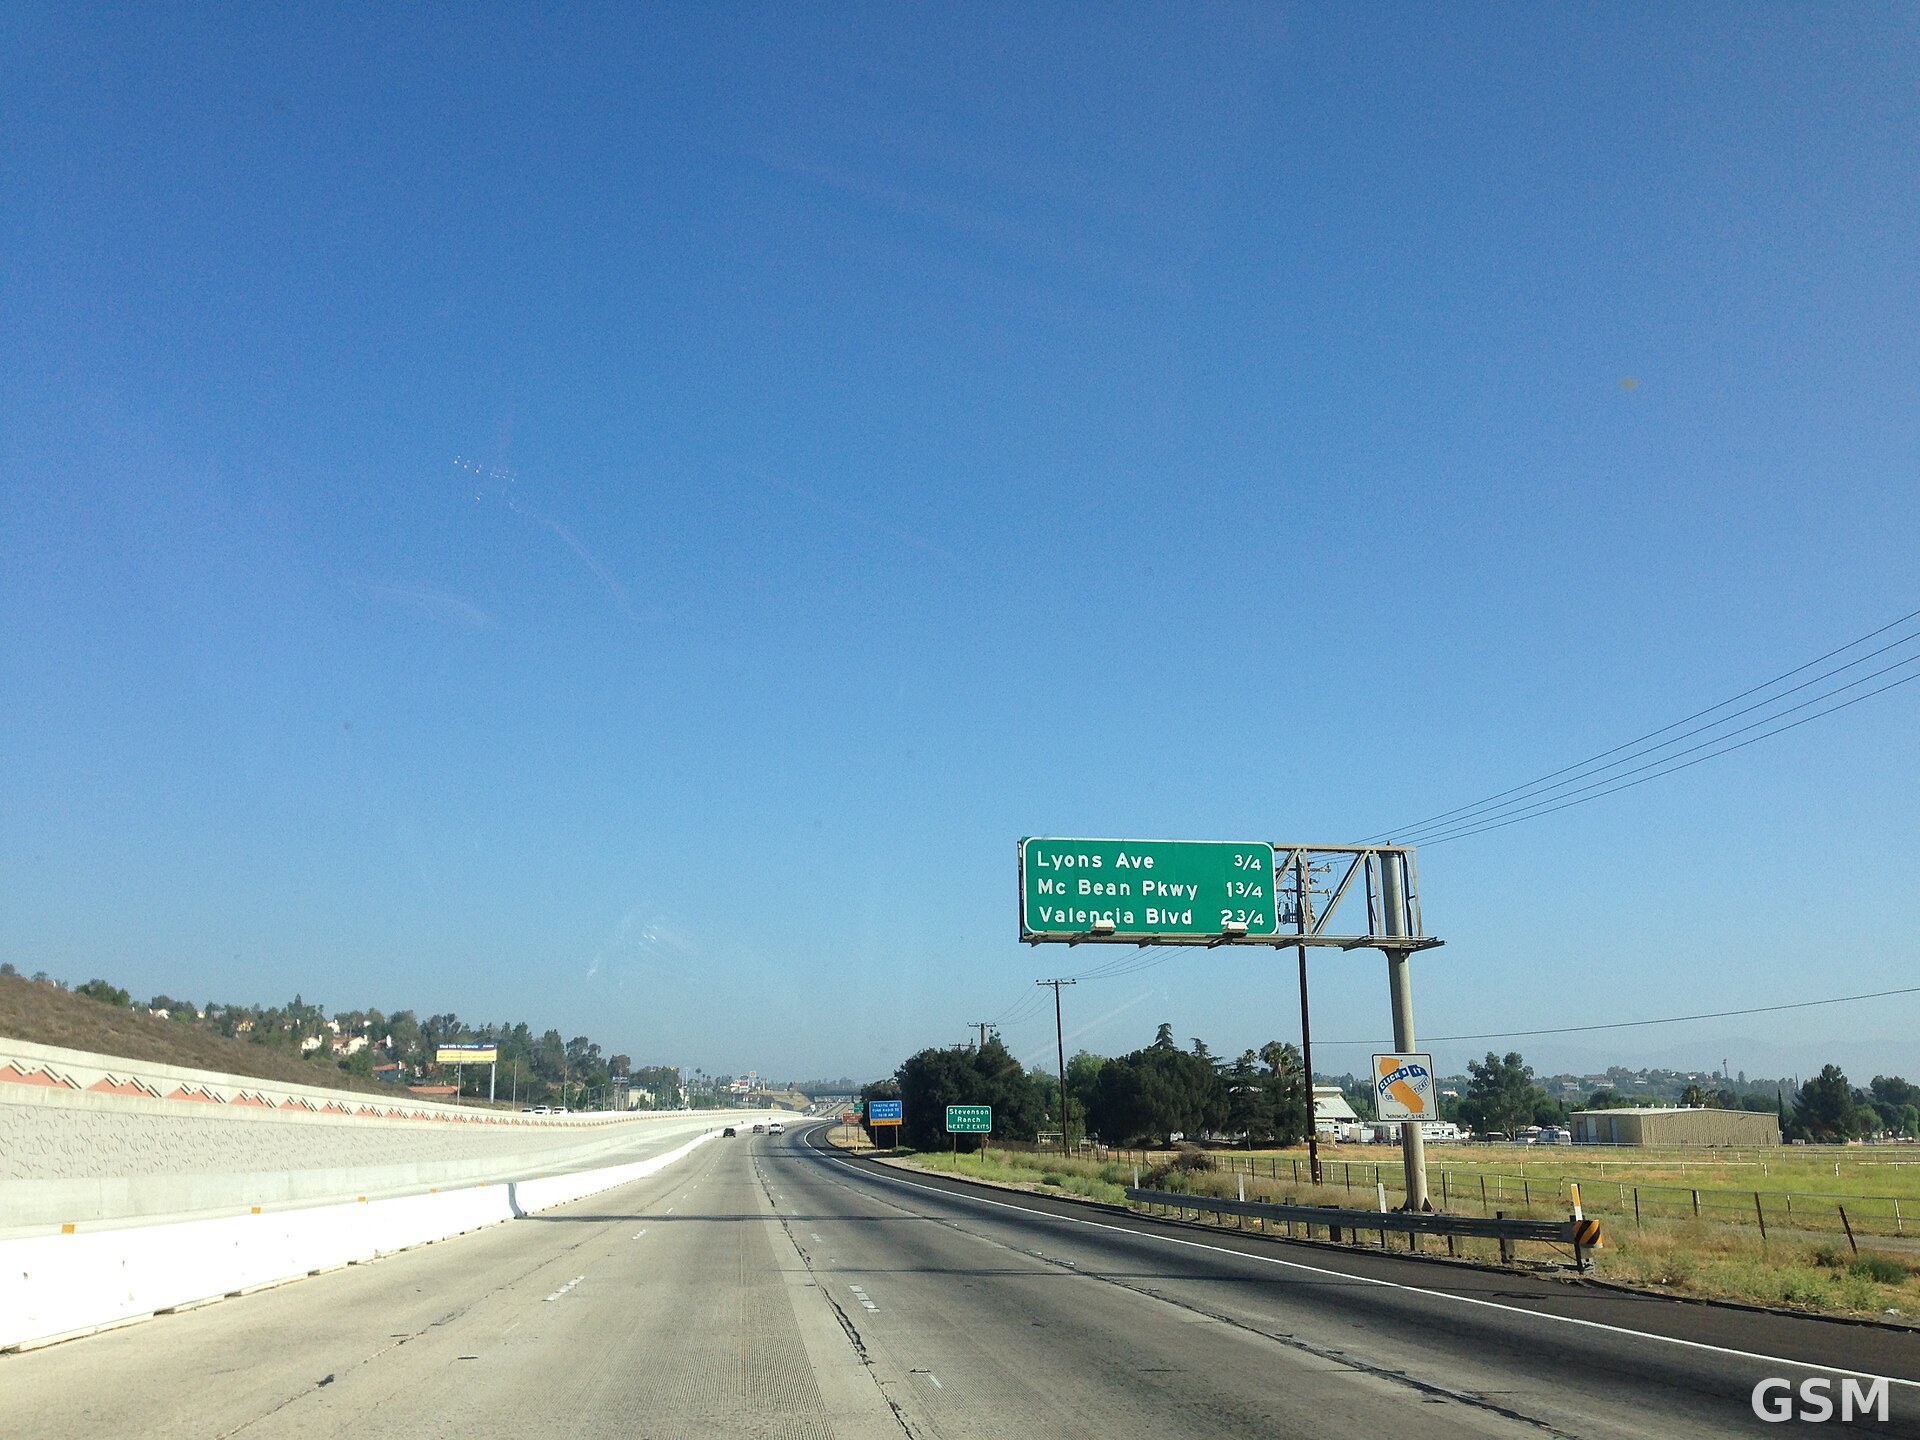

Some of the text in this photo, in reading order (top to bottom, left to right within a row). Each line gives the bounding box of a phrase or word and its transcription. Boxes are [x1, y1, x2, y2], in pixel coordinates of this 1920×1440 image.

[1037, 851, 1102, 871] Lyons
[1115, 852, 1154, 868] Ave
[1037, 879, 1066, 895] Mc
[1078, 879, 1130, 896] Bean
[1142, 880, 1198, 900] Pkwy
[1039, 906, 1134, 924] Valencia
[1146, 908, 1192, 925] Blvd
[1380, 1073, 1401, 1089] CLICK
[1414, 1078, 1428, 1093] TICKET
[957, 1115, 981, 1123] Ranch
